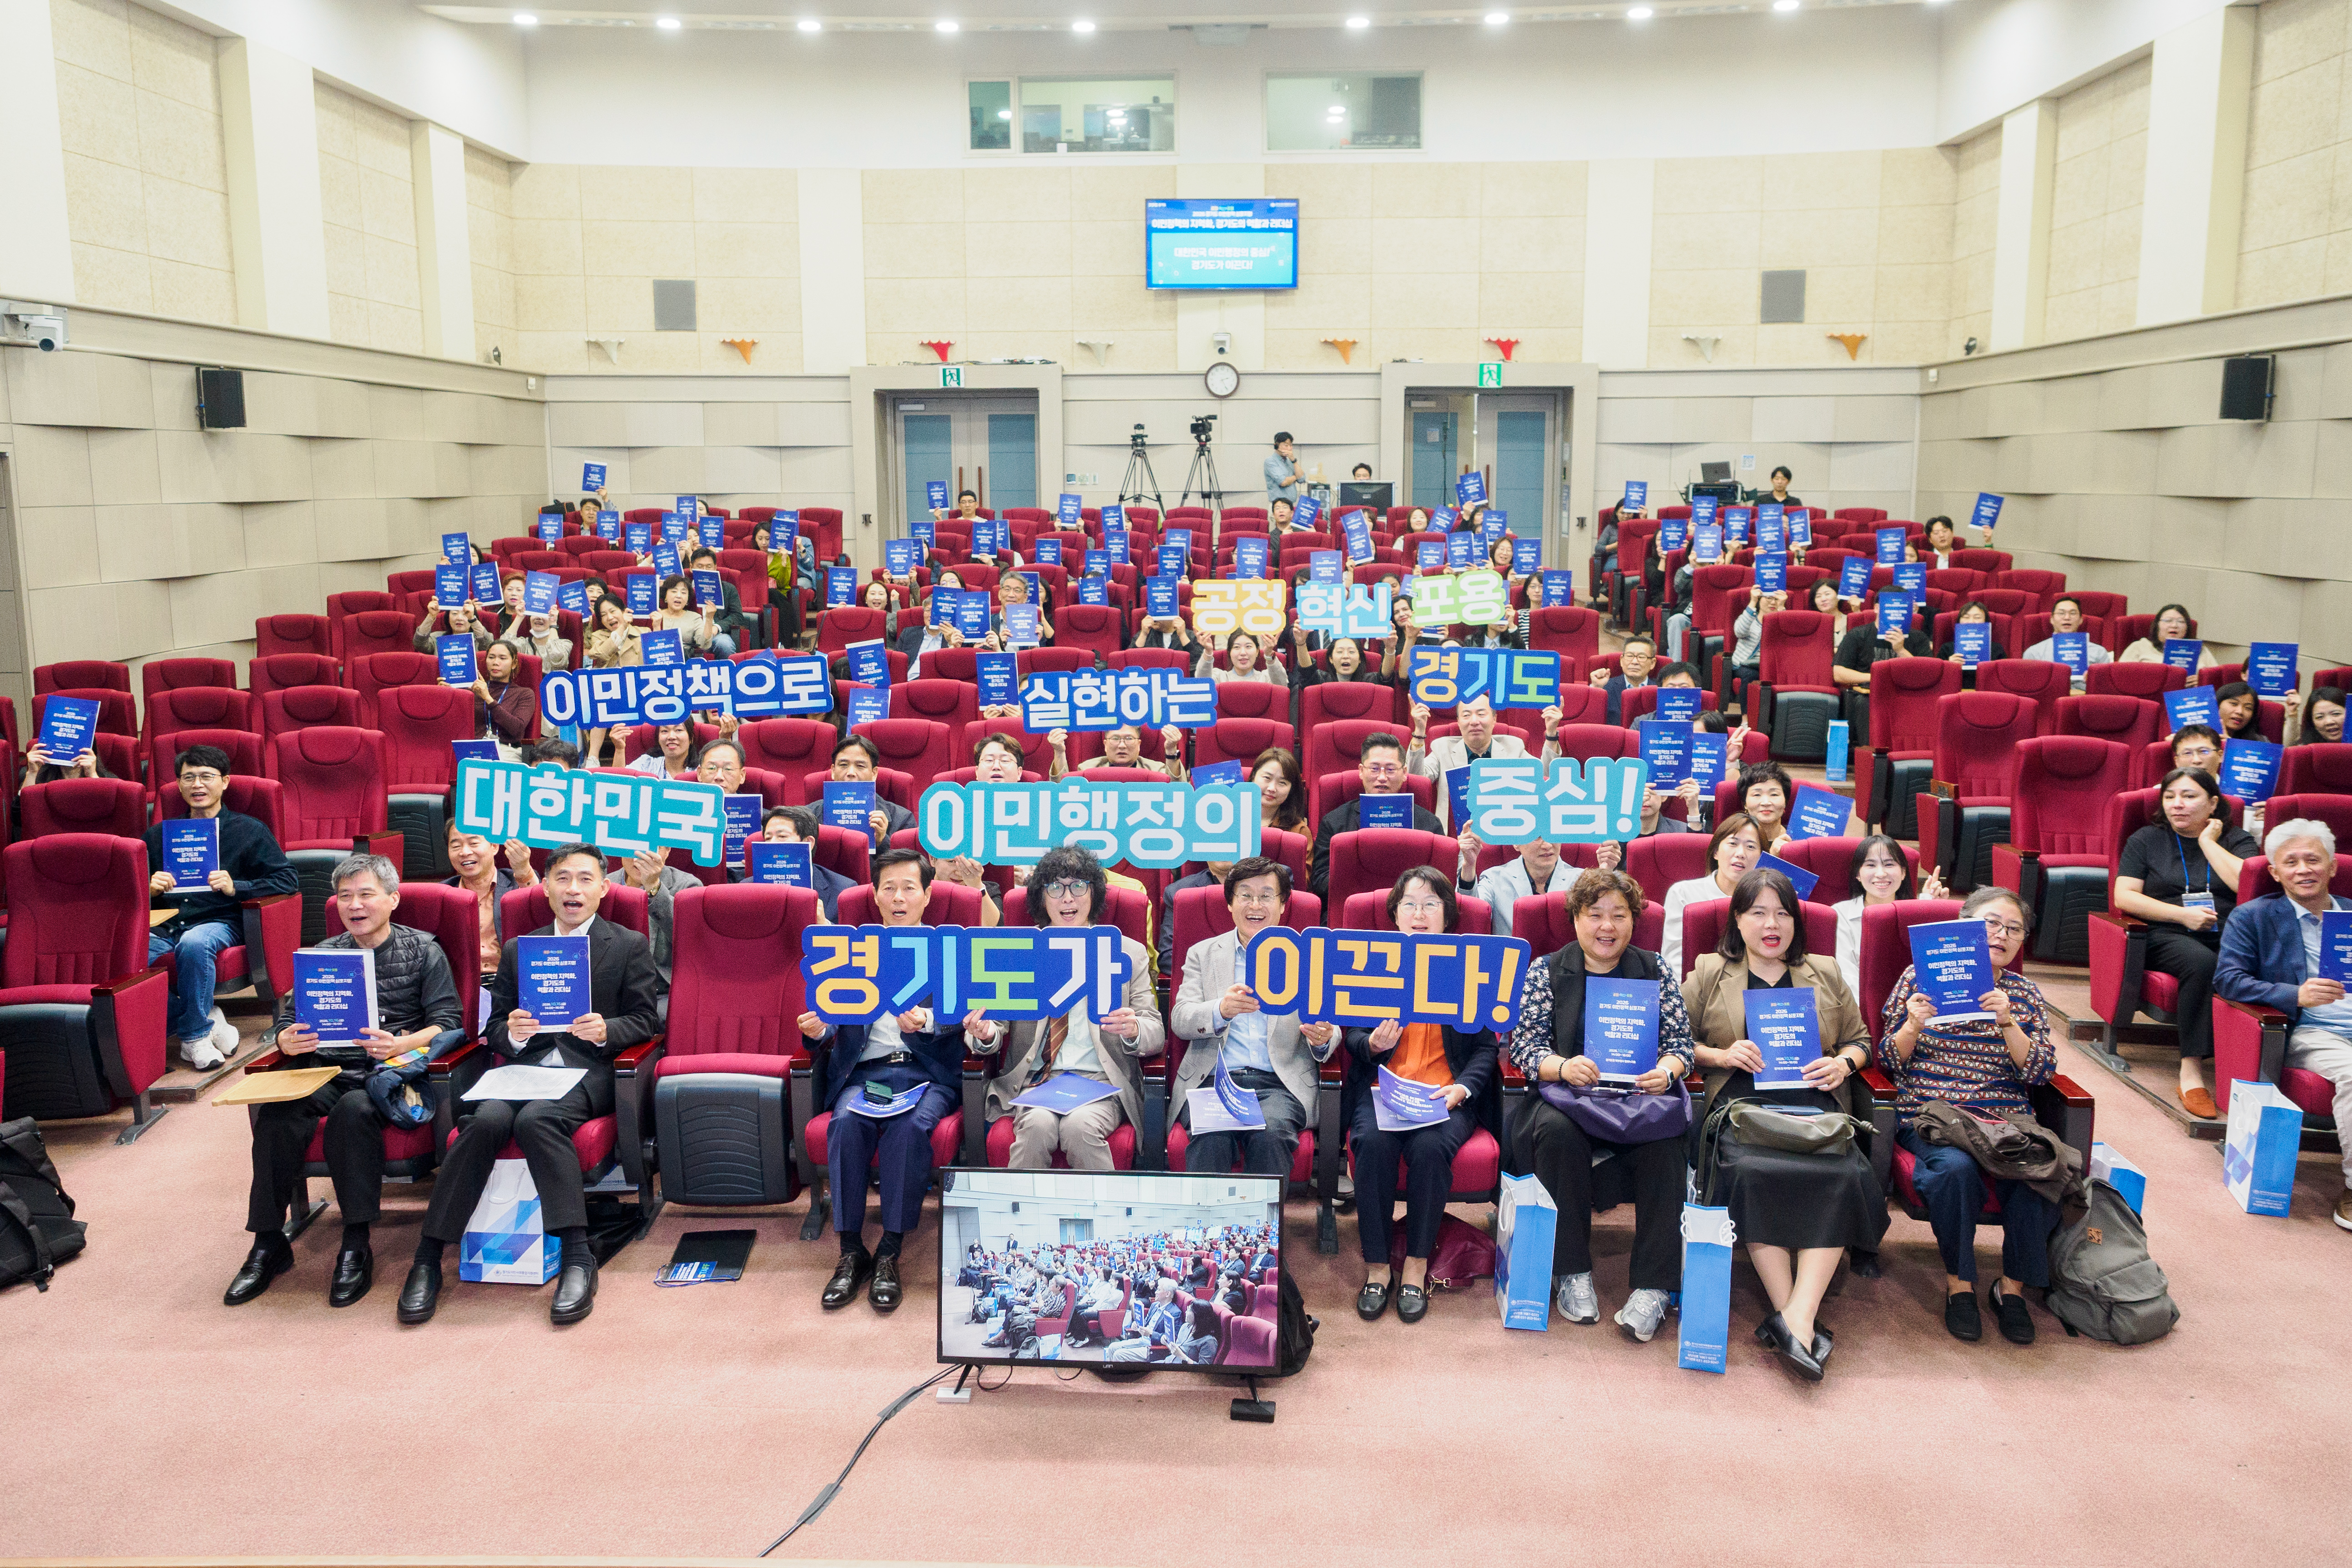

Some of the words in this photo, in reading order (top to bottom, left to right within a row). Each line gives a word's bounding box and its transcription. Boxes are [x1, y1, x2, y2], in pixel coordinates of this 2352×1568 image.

[1152, 219, 1189, 228] 이민정책의
[1190, 219, 1215, 229] 지역화,
[1216, 219, 1246, 228] 경기도의
[1247, 219, 1269, 228] 역할과
[1270, 219, 1292, 228] 리더십
[1174, 247, 1206, 257] 대한민국
[1208, 247, 1248, 257] 이민행정의
[1251, 247, 1270, 257] 중심!
[1191, 260, 1223, 270] 경기도가
[1225, 260, 1252, 270] 이끈다!
[1194, 581, 1284, 634] 공정
[1299, 585, 1389, 635] 혁신
[1415, 573, 1503, 624] 포용
[546, 661, 827, 724] 이민정책으로
[1025, 673, 1212, 729] 실현하는
[1414, 651, 1556, 703] 경기도
[463, 767, 720, 858] 대한민국
[927, 786, 1252, 860] 이민행정의
[1476, 766, 1638, 836] 중심!
[810, 935, 1121, 1015] 경기도가
[1255, 936, 1520, 1023] 이끈다!
[1928, 961, 1956, 969] 이민정책의
[697, 1263, 710, 1278] STAFF
